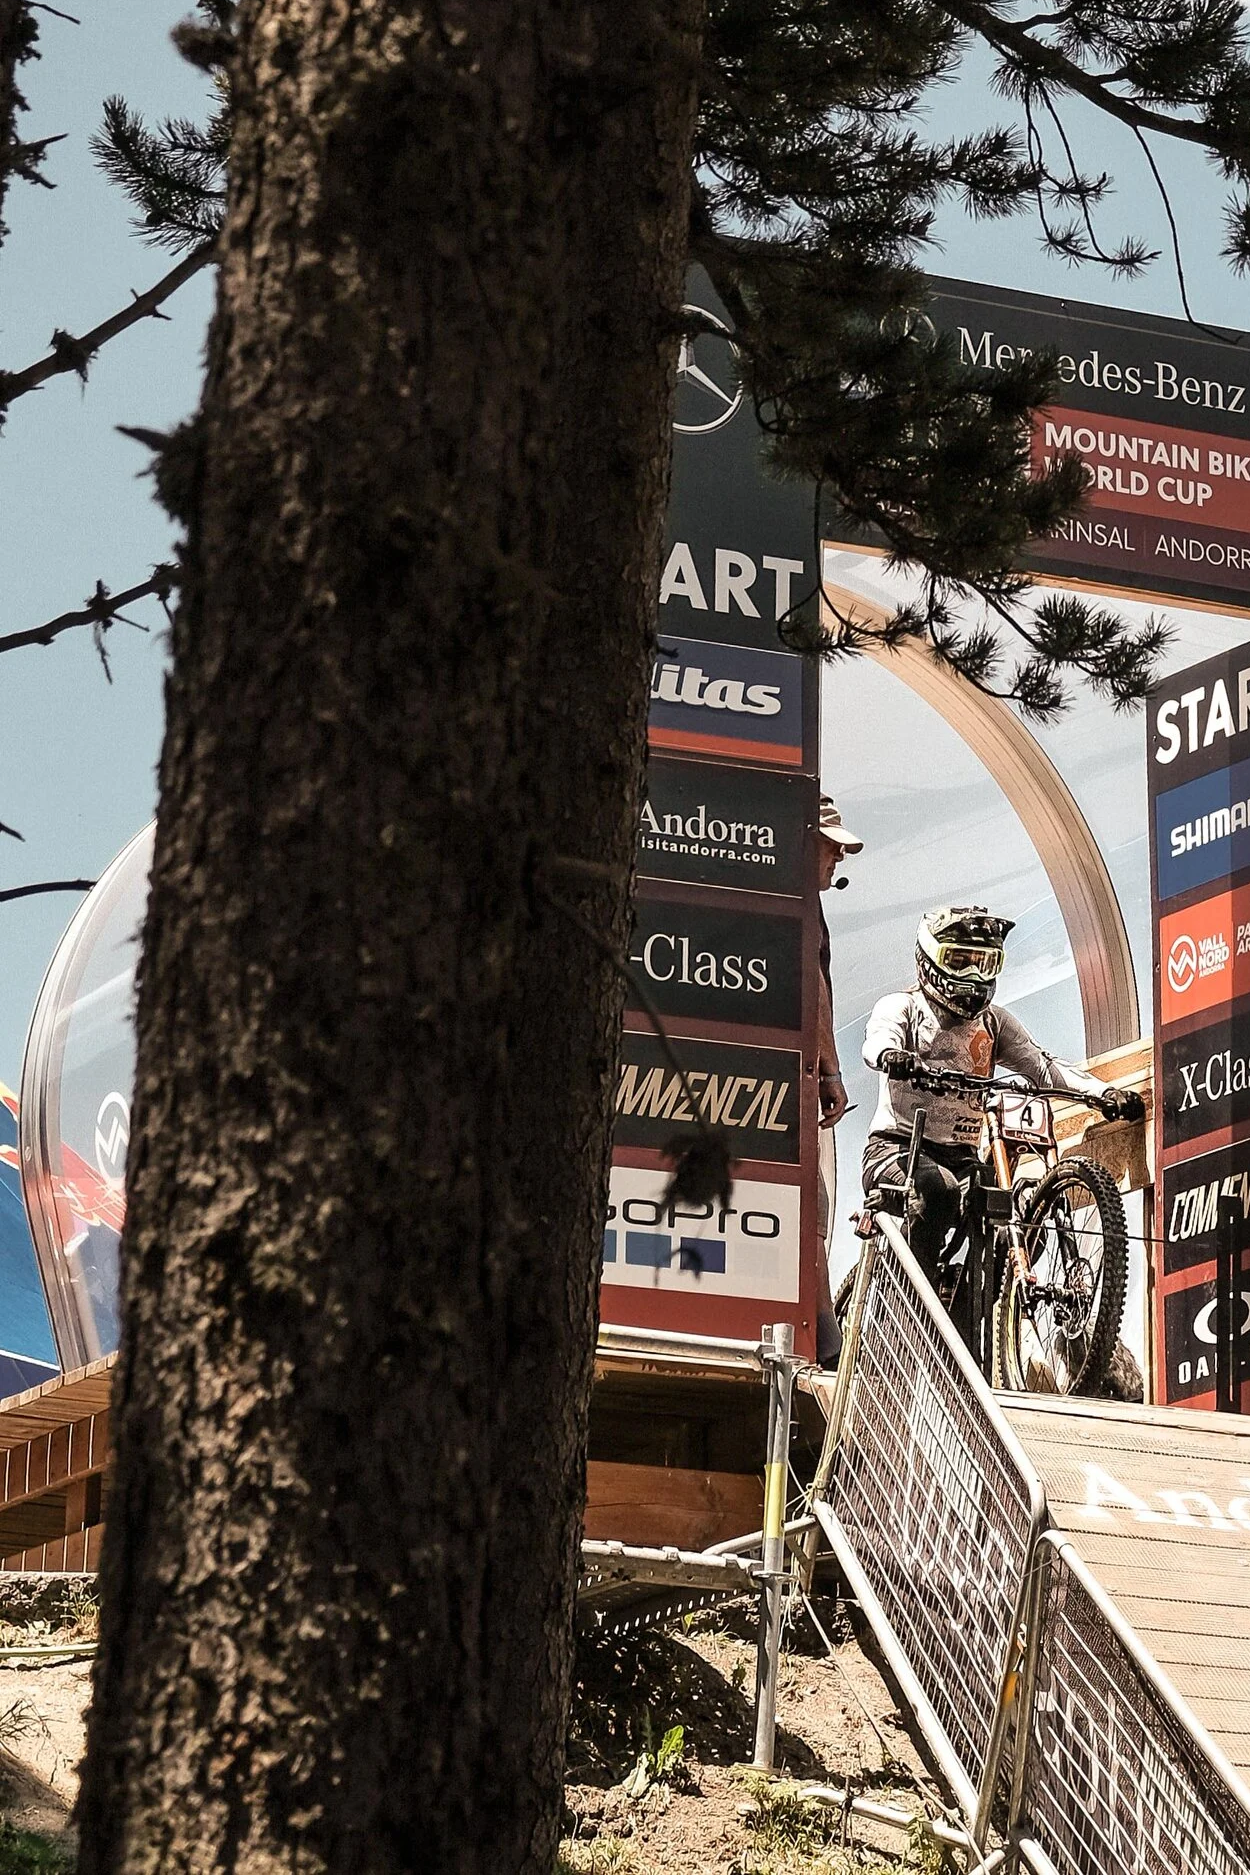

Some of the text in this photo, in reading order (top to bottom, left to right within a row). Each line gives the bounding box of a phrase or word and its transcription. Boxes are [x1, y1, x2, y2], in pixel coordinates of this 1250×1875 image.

[956, 326, 1247, 414] Meredes-Benz
[1044, 421, 1200, 473] MOUNTAIN
[1157, 477, 1213, 507] CUP
[1050, 516, 1136, 552] RINSAL
[658, 541, 804, 624] ART
[650, 661, 782, 716] itas
[641, 799, 776, 848] Andorra
[641, 836, 776, 865] isitandorra.com
[629, 933, 769, 994] -Class
[1197, 932, 1227, 955] VALL
[1198, 945, 1230, 971] NORD
[614, 1063, 790, 1133] MMENCAL
[1021, 1104, 1035, 1127] 4
